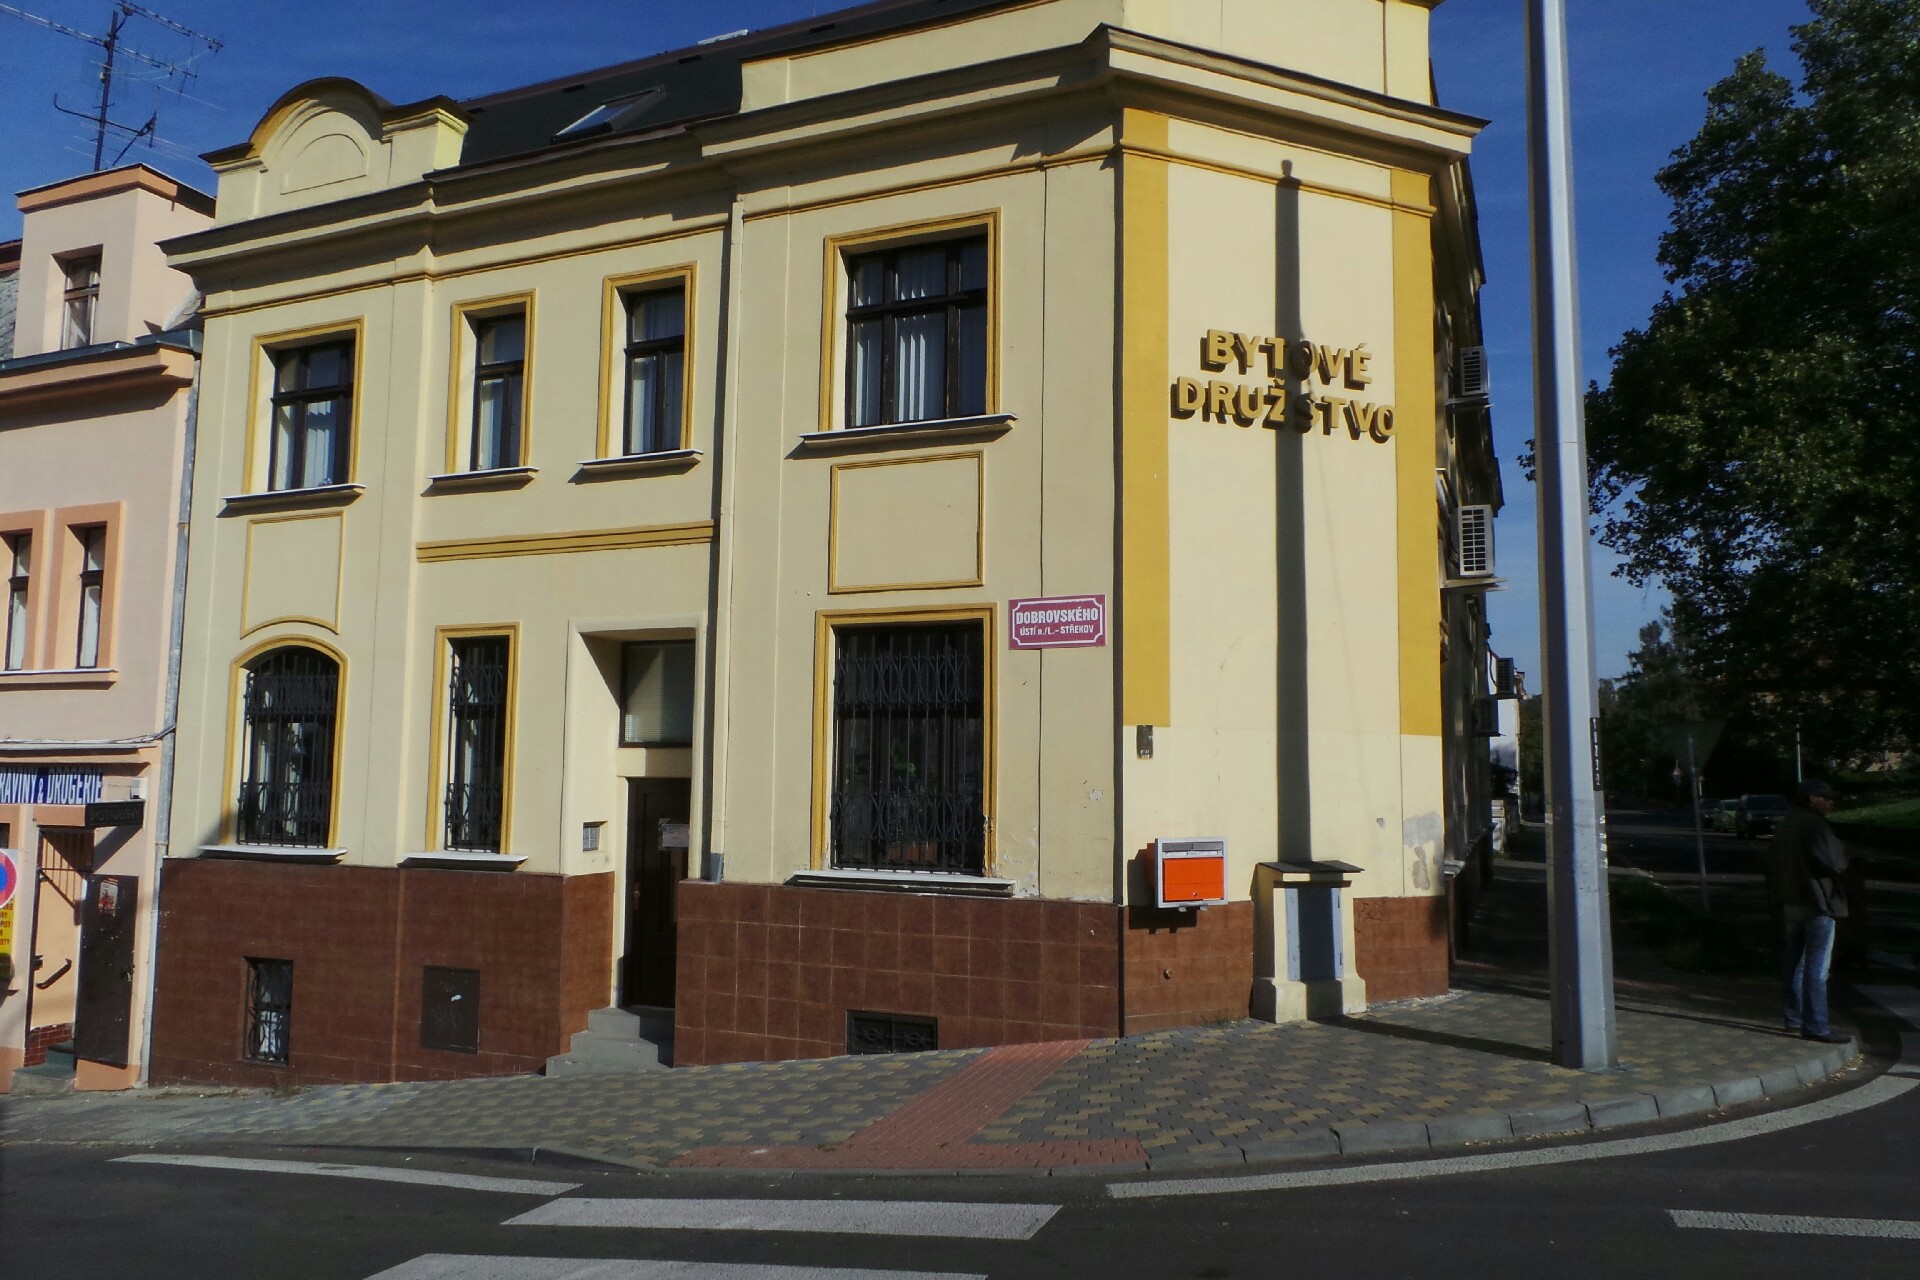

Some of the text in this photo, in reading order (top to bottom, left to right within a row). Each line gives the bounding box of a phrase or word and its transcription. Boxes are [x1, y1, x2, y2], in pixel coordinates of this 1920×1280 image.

[1207, 329, 1373, 385] BYTOVÉ
[1177, 376, 1397, 437] DRUŽSTVO
[1016, 606, 1098, 624] DOBROVSKÉHO
[1020, 625, 1037, 636] ÚSTÍ
[37, 777, 44, 803] &
[46, 767, 103, 804] DROGERIE
